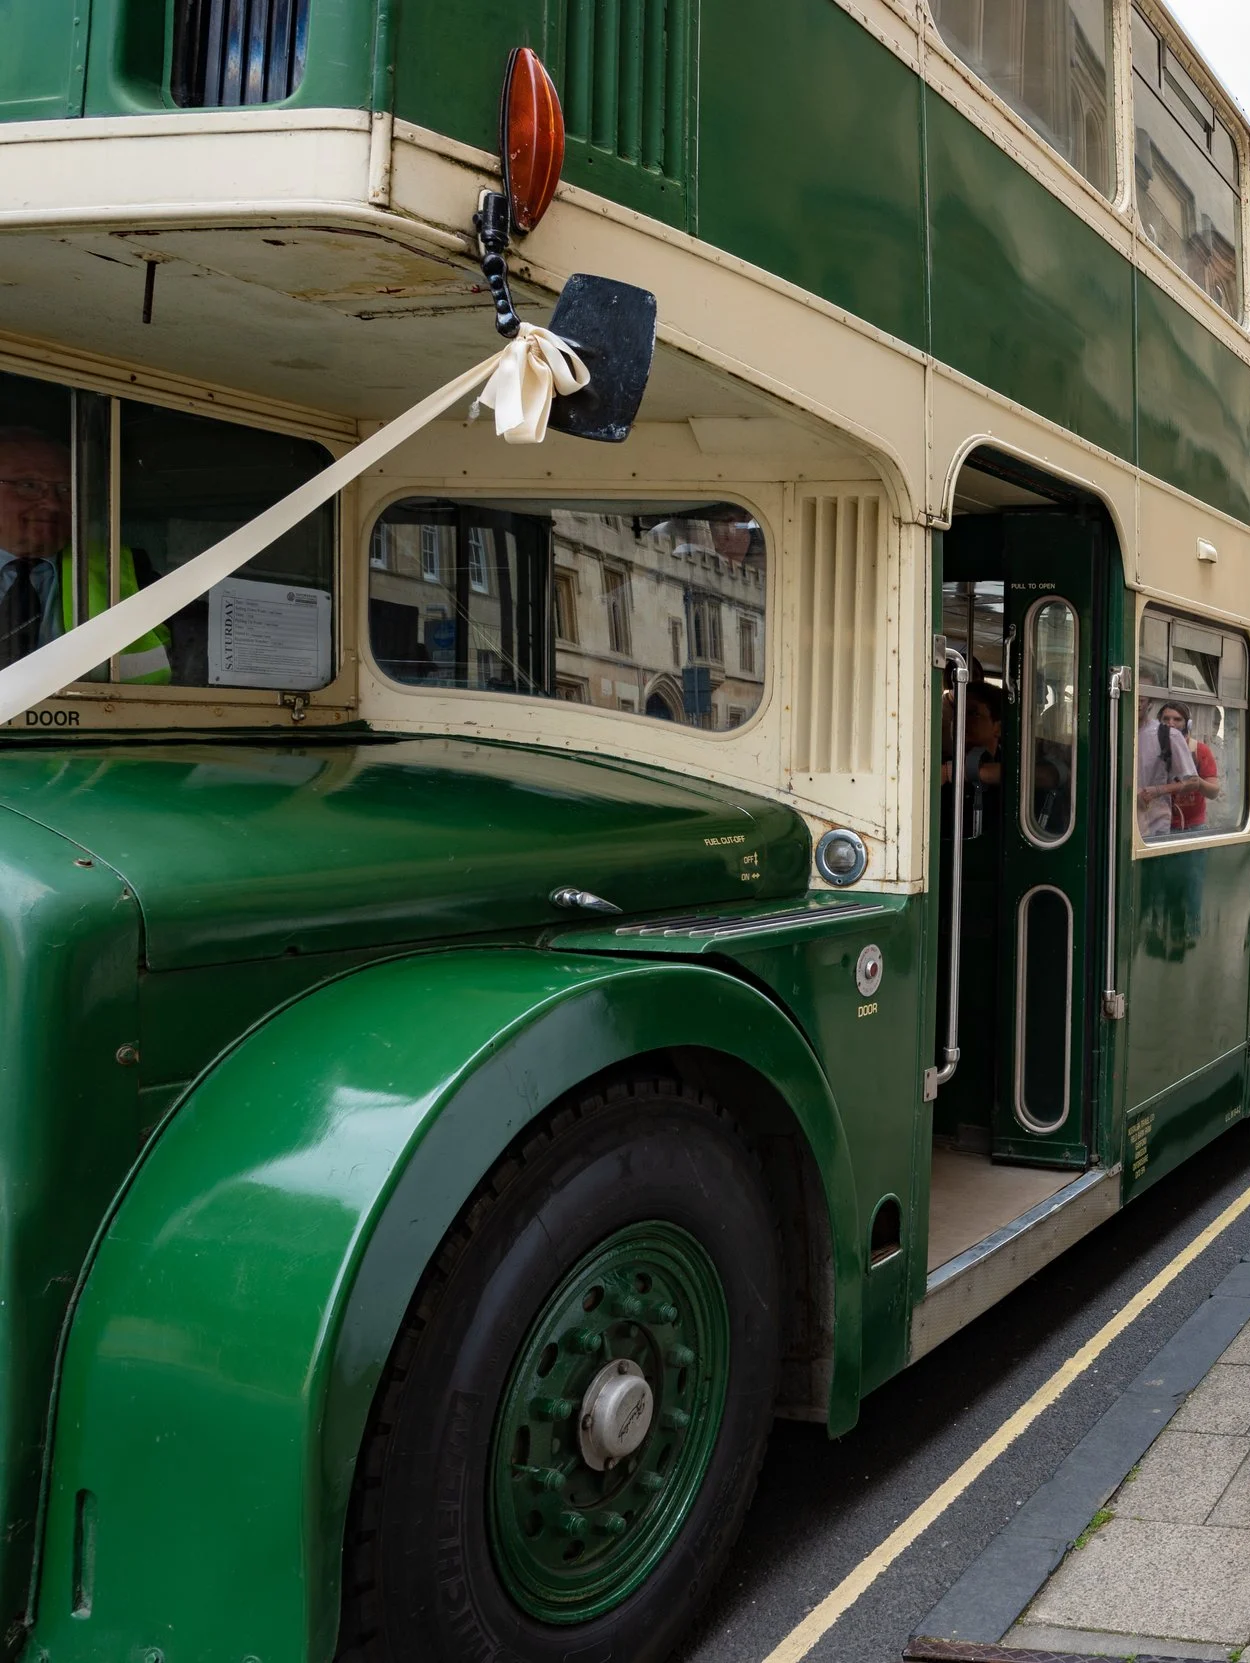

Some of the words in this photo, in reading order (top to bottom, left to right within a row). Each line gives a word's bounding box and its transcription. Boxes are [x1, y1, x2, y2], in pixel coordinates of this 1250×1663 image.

[224, 600, 234, 670] SATURDAY
[26, 710, 80, 726] DOOR
[704, 837, 721, 846] FUEL
[720, 835, 745, 845] CUT-OFF
[743, 855, 754, 864] OFF
[741, 873, 750, 881] ON
[857, 1002, 878, 1018] DOOR
